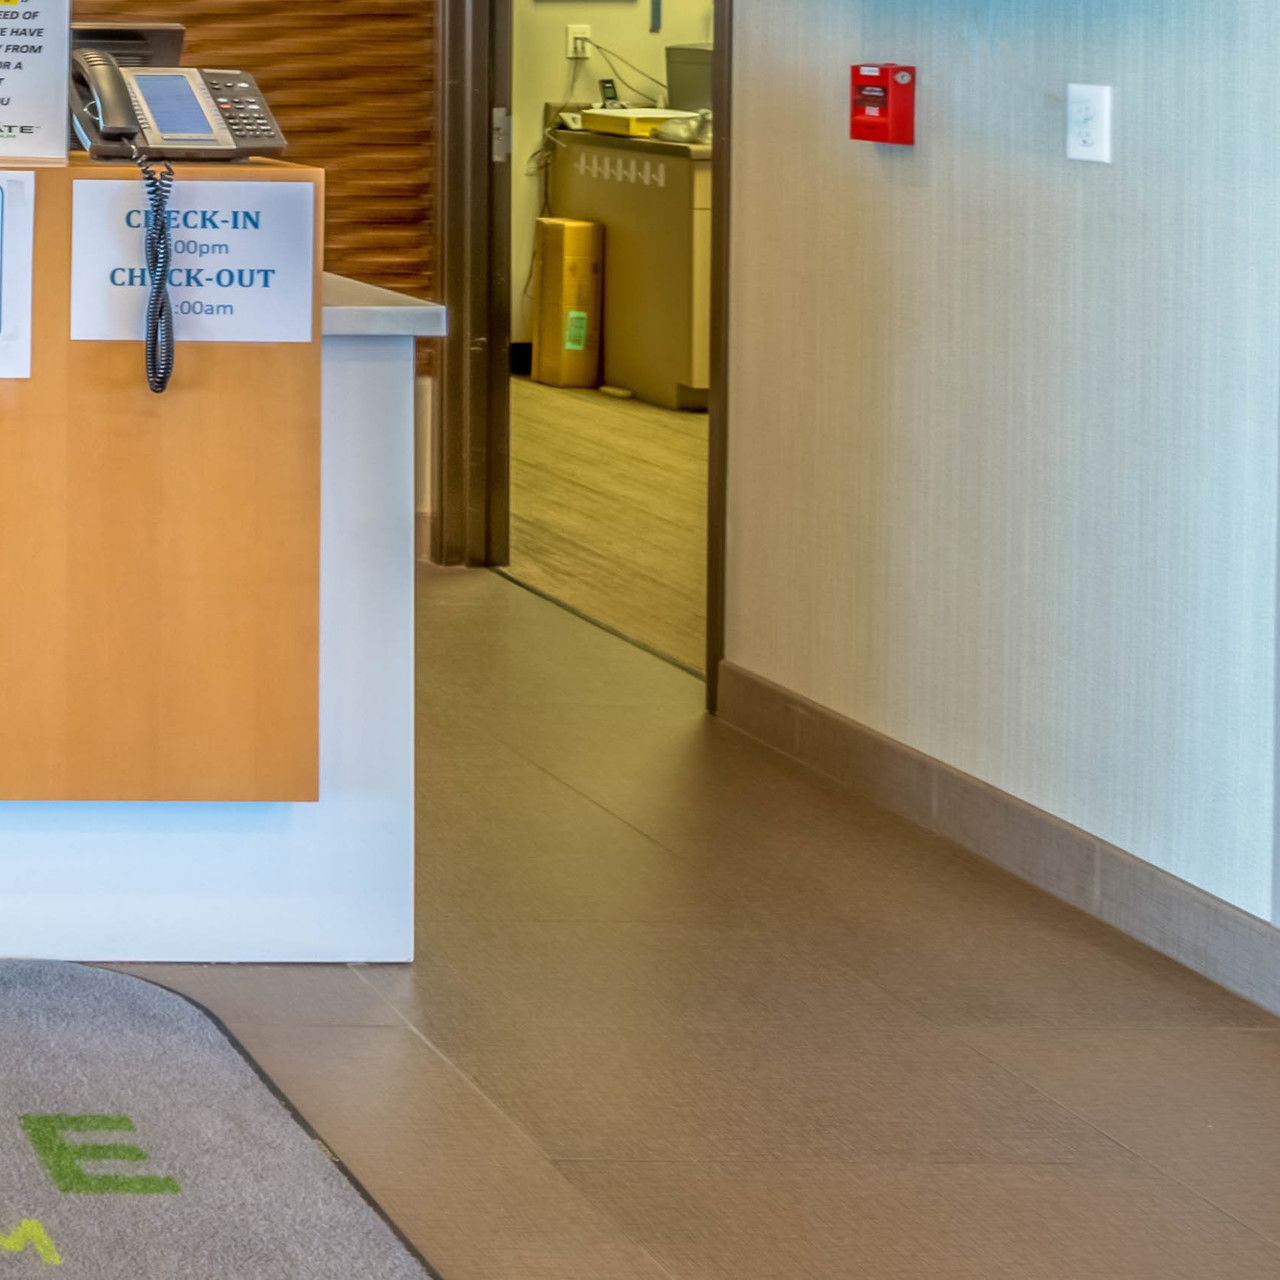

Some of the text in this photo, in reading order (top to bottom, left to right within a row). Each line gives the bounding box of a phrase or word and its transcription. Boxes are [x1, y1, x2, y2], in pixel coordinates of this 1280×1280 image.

[22, 11, 40, 20] OF
[9, 28, 44, 37] HAVE
[4, 44, 43, 54] FROM
[13, 61, 23, 70] A
[109, 267, 276, 288] CHCK-OUT
